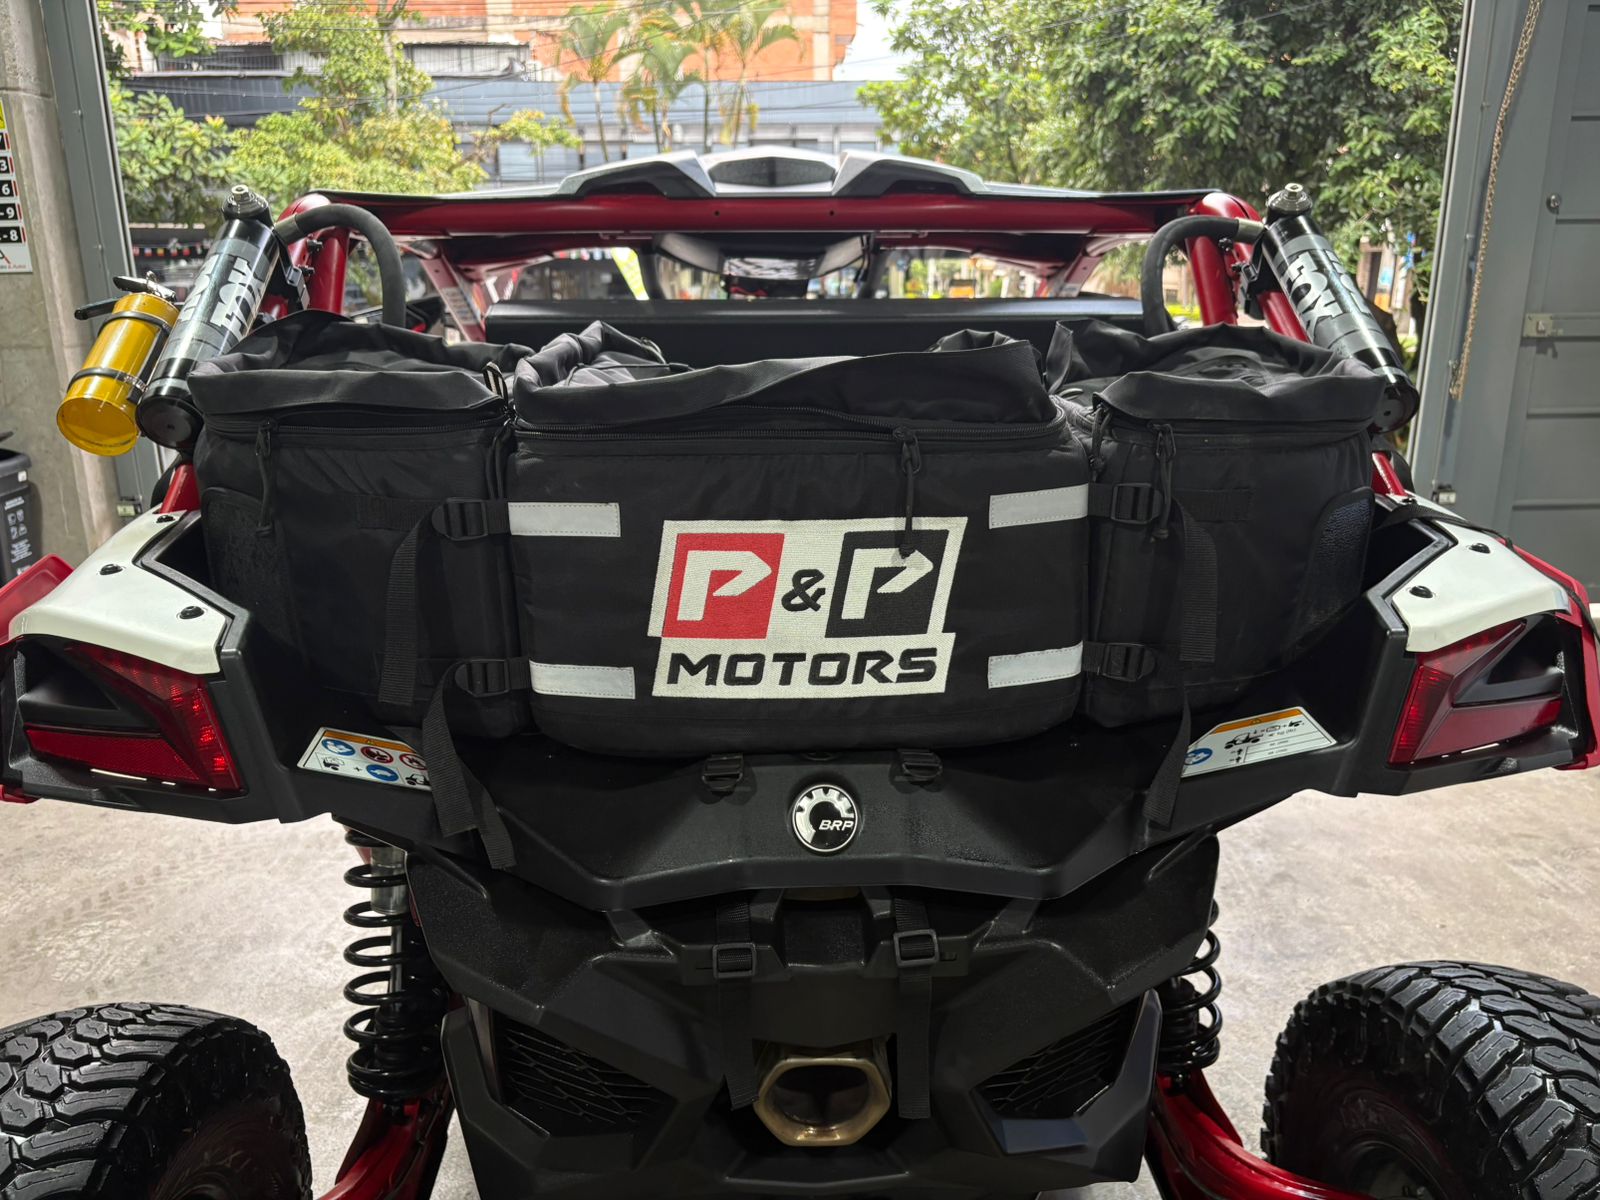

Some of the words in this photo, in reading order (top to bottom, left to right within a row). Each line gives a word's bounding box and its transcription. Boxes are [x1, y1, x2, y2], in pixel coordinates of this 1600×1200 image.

[211, 257, 263, 341] FOX
[1281, 251, 1343, 343] FOX
[667, 647, 937, 686] MOTORS
[818, 819, 855, 831] BRP
